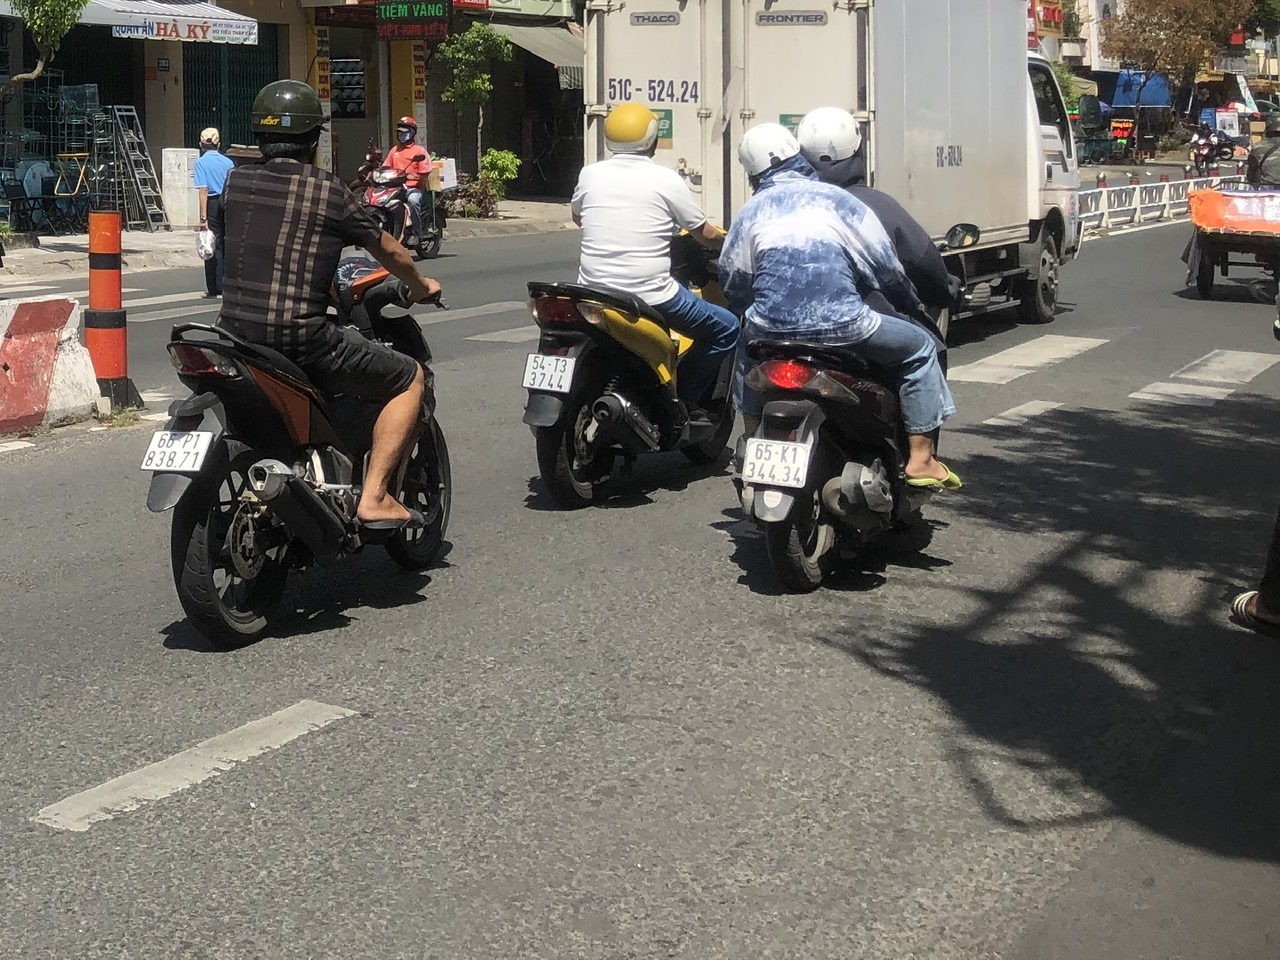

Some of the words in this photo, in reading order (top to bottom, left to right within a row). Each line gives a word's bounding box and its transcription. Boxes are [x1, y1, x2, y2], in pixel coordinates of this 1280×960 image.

[380, 2, 408, 20] TIỆM
[412, 1, 443, 17] VÀNG
[634, 14, 676, 23] THACO
[758, 14, 824, 23] FRONTIER
[155, 19, 181, 38] HÀ
[186, 21, 211, 39] KÝ
[608, 78, 632, 101] 51C
[648, 80, 699, 103] 524.24
[532, 356, 567, 373] 54-T3
[529, 371, 563, 390] 3744
[145, 450, 200, 468] 838.71
[755, 443, 797, 465] 65-K1
[746, 462, 801, 483] 344.34
